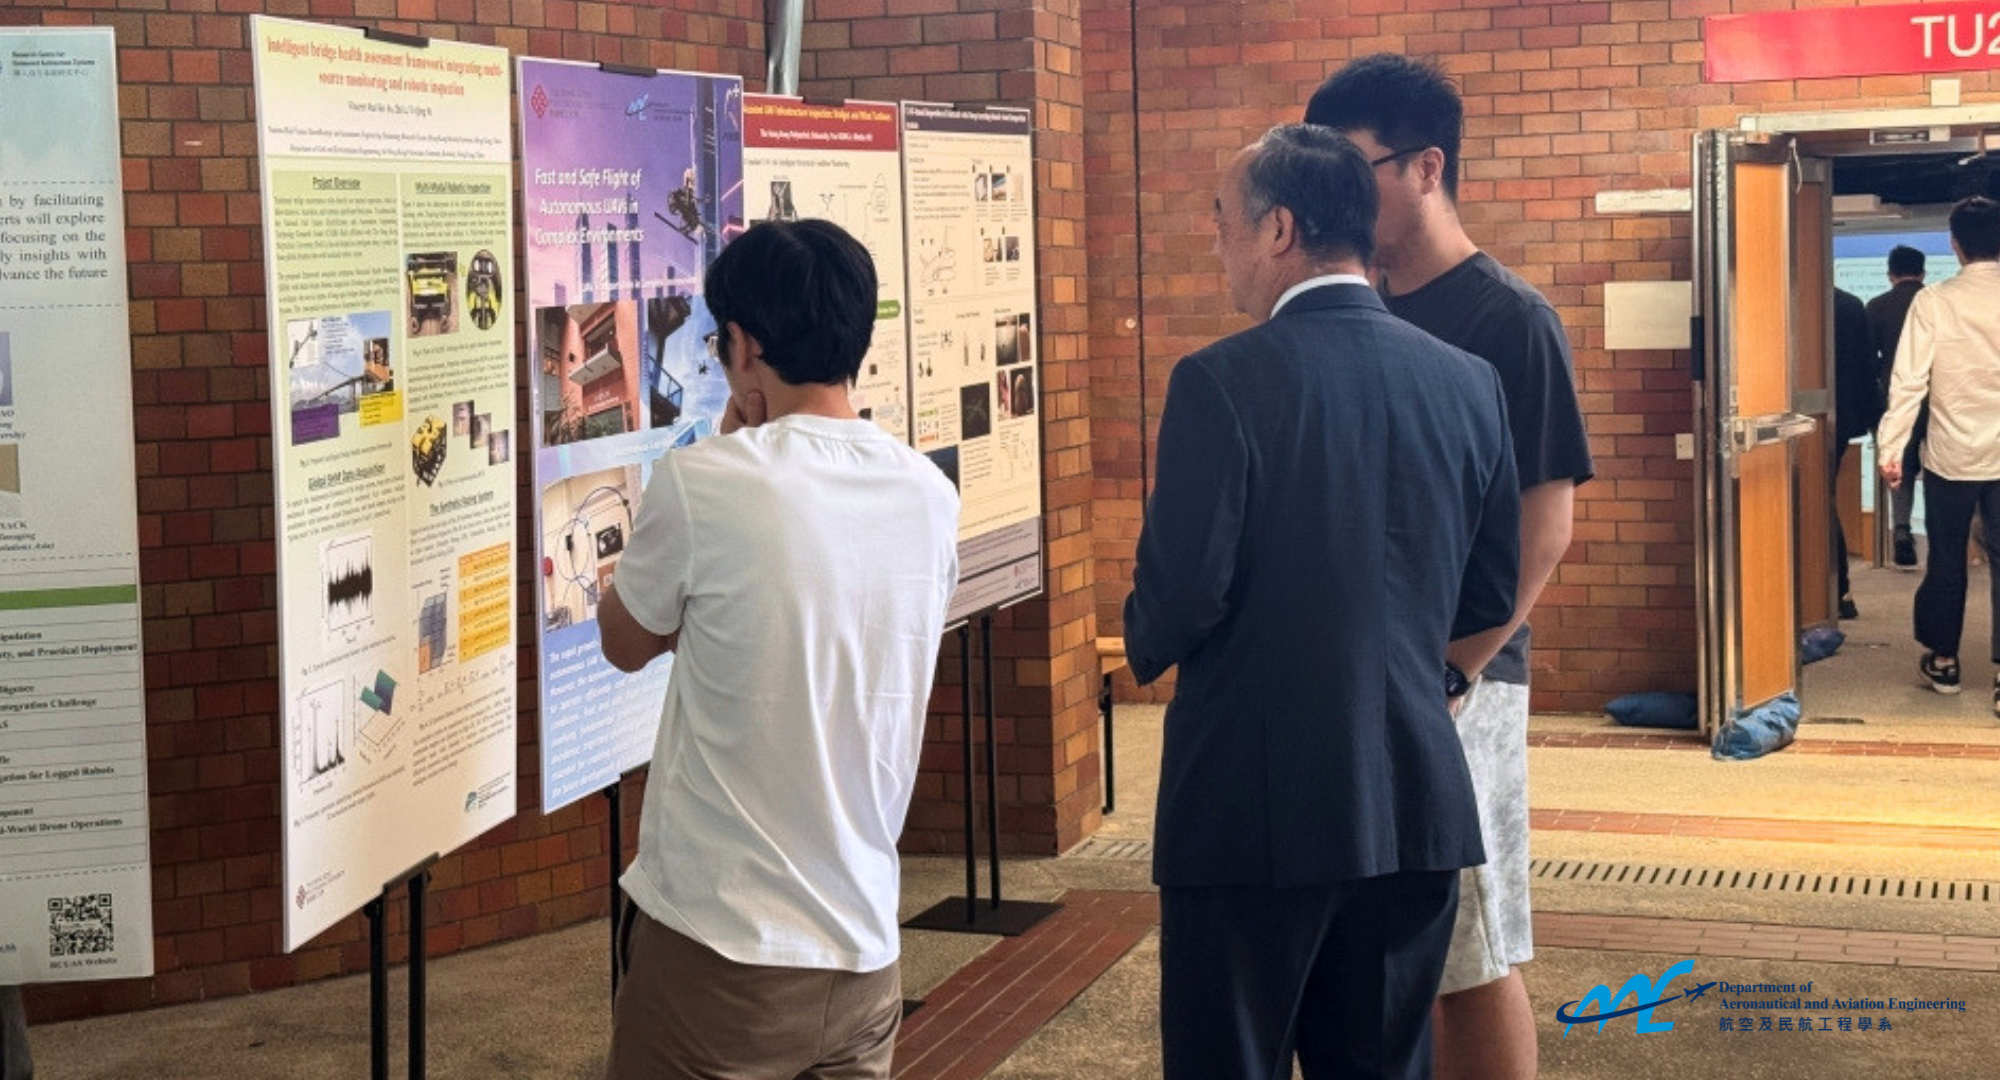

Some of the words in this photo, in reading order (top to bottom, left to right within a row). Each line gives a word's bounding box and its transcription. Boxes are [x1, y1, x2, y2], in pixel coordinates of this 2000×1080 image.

[267, 36, 309, 58] Intelligent
[311, 41, 337, 62] bridge
[535, 168, 557, 185] Fast
[558, 168, 576, 185] and
[579, 168, 600, 188] Safe
[603, 168, 629, 189] Flight
[631, 168, 643, 190] of
[9, 194, 25, 210] by
[34, 193, 105, 208] facilitating
[539, 199, 601, 214] Autonomous
[604, 199, 627, 214] UAVs
[628, 199, 639, 214] in
[26, 213, 51, 225] will
[56, 211, 105, 227] explore
[0, 231, 57, 246] focusing
[62, 234, 79, 243] on
[85, 229, 106, 242] the
[535, 228, 577, 246] Complex
[581, 228, 645, 244] Environments
[19, 248, 71, 265] insights
[77, 246, 107, 261] with
[44, 267, 64, 280] the
[68, 265, 108, 279] future
[17, 649, 35, 658] and
[37, 645, 80, 658] Practical
[50, 697, 98, 709] Challenge
[29, 769, 44, 780] for
[81, 764, 115, 776] Robots
[39, 822, 68, 832] Drone
[70, 818, 123, 831] Operations
